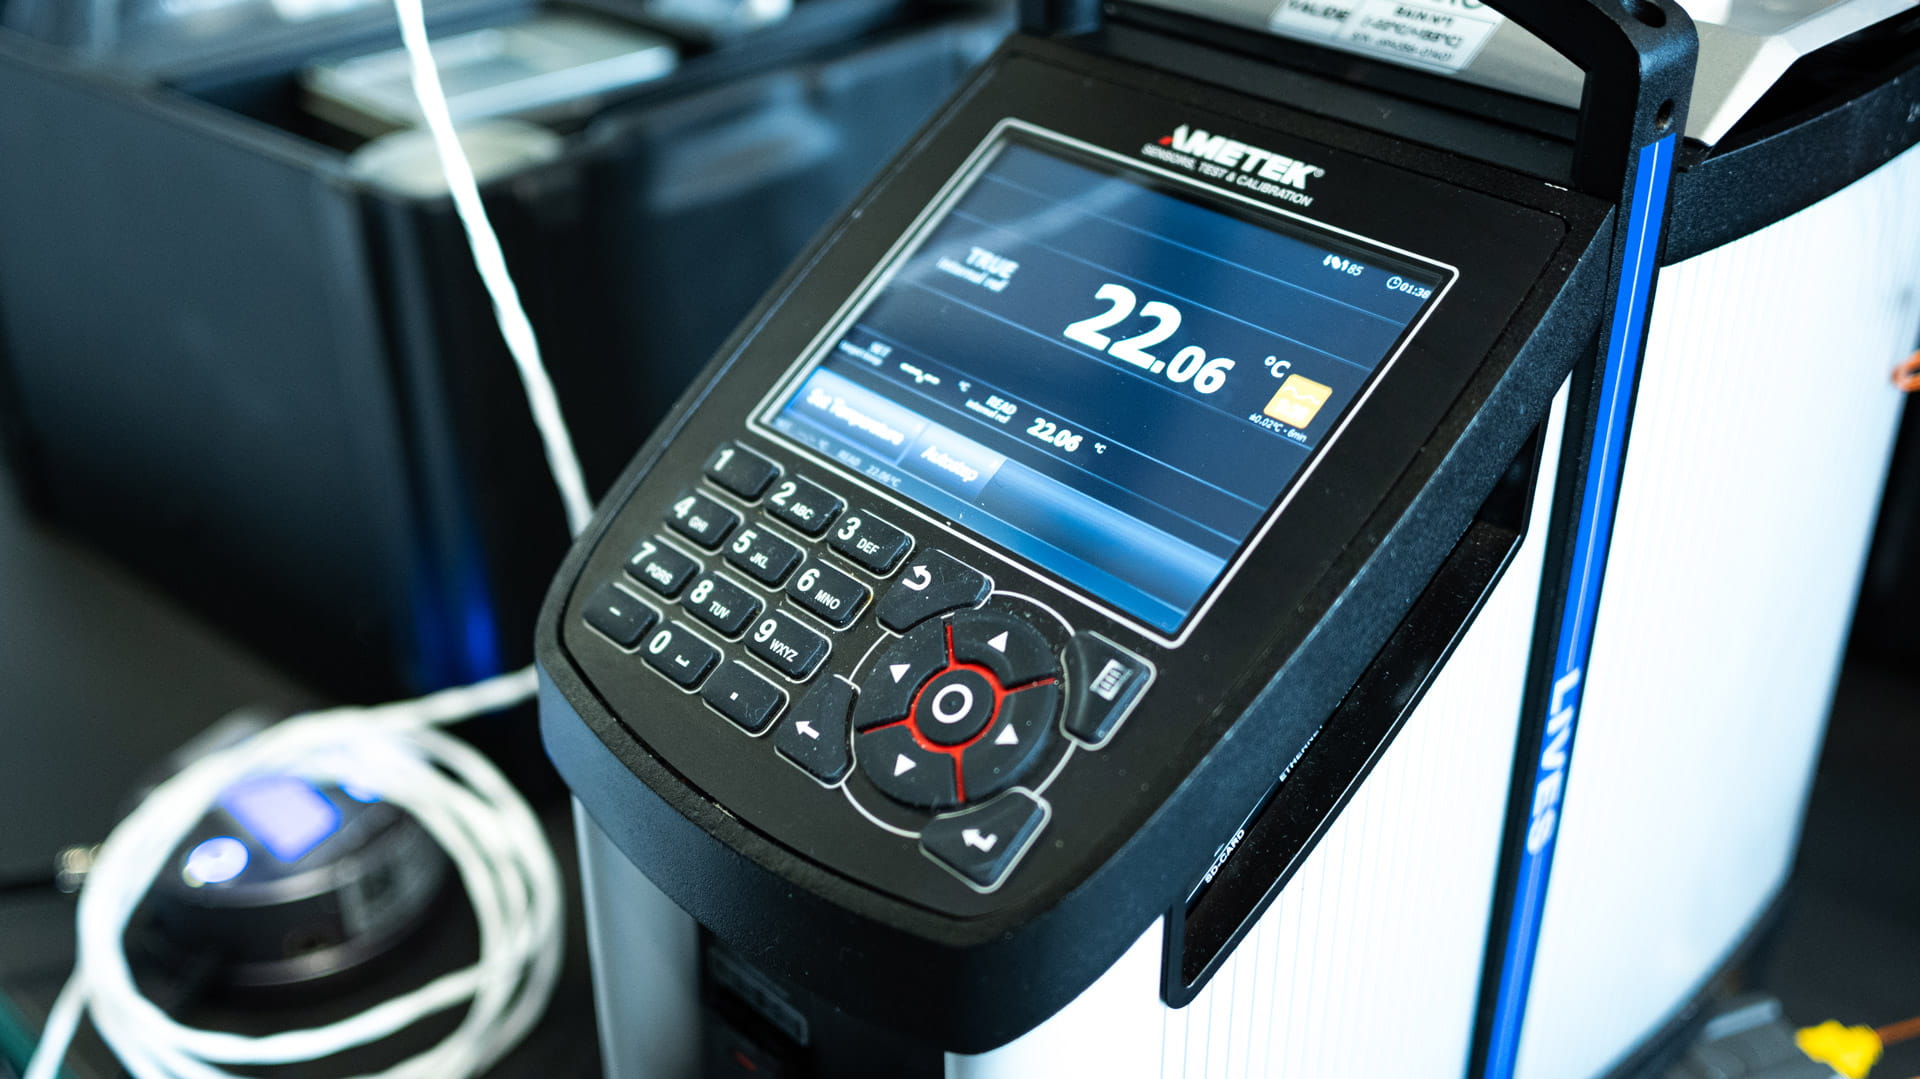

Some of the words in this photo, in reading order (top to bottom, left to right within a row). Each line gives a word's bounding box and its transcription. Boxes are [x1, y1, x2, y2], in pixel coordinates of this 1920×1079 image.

[1198, 161, 1227, 179] TEST
[1225, 172, 1236, 183] &
[1237, 175, 1314, 207] CALIBRATION
[966, 246, 1019, 279] TRUE
[1063, 283, 1236, 394] 22.06
[1264, 355, 1291, 378] °C
[985, 395, 1018, 415] READ
[1026, 417, 1083, 452] 22.06
[712, 449, 734, 472] 1
[673, 496, 697, 519] 4
[770, 481, 796, 505] 2
[790, 502, 815, 521] ABC
[631, 542, 656, 565] 7
[732, 529, 757, 553] 5
[750, 551, 768, 569] JKL
[837, 517, 861, 541] 3
[856, 537, 880, 555] DEF
[690, 579, 714, 603] 8
[708, 600, 731, 620] TUV
[796, 568, 820, 592] 6
[814, 589, 841, 610] MNO
[649, 630, 672, 655] 0
[754, 619, 777, 643] 9
[770, 638, 799, 663] WXYZ
[1527, 667, 1580, 855] LIVES
[1204, 829, 1245, 884] SD-CARD
